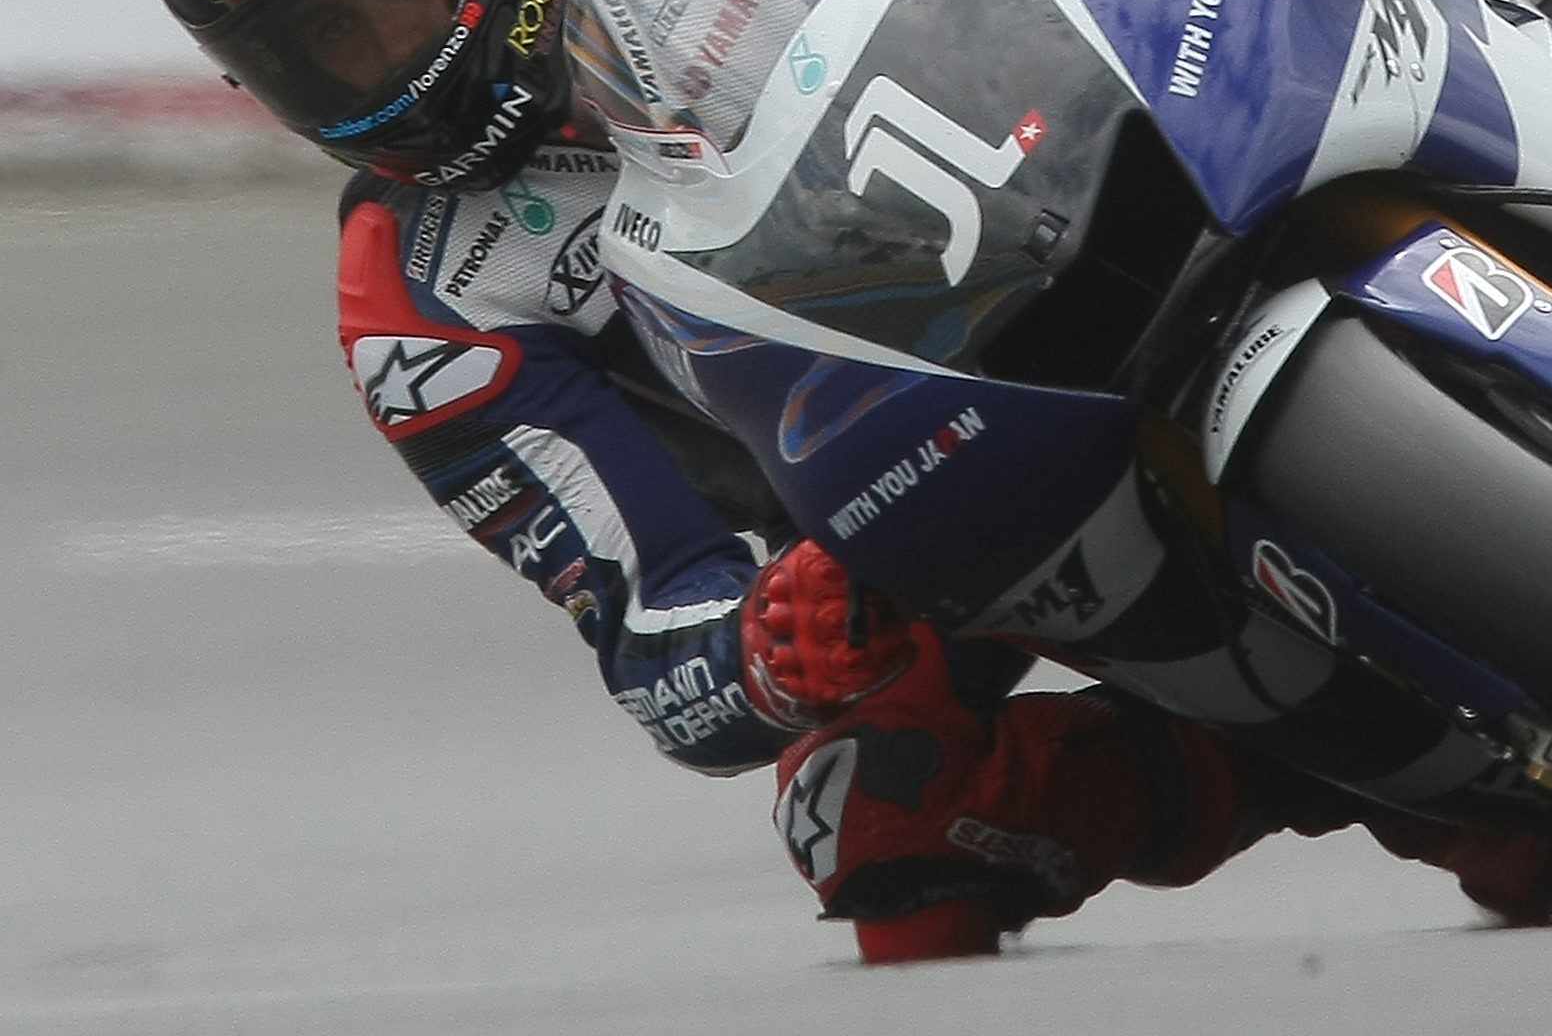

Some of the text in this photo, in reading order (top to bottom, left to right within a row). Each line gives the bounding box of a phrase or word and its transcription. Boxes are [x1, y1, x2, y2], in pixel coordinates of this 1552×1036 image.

[1169, 25, 1214, 99] WITH
[414, 85, 535, 187] GARMIN
[446, 210, 511, 298] PETRONAS
[613, 202, 662, 253] IVECO
[870, 460, 920, 508] YOU
